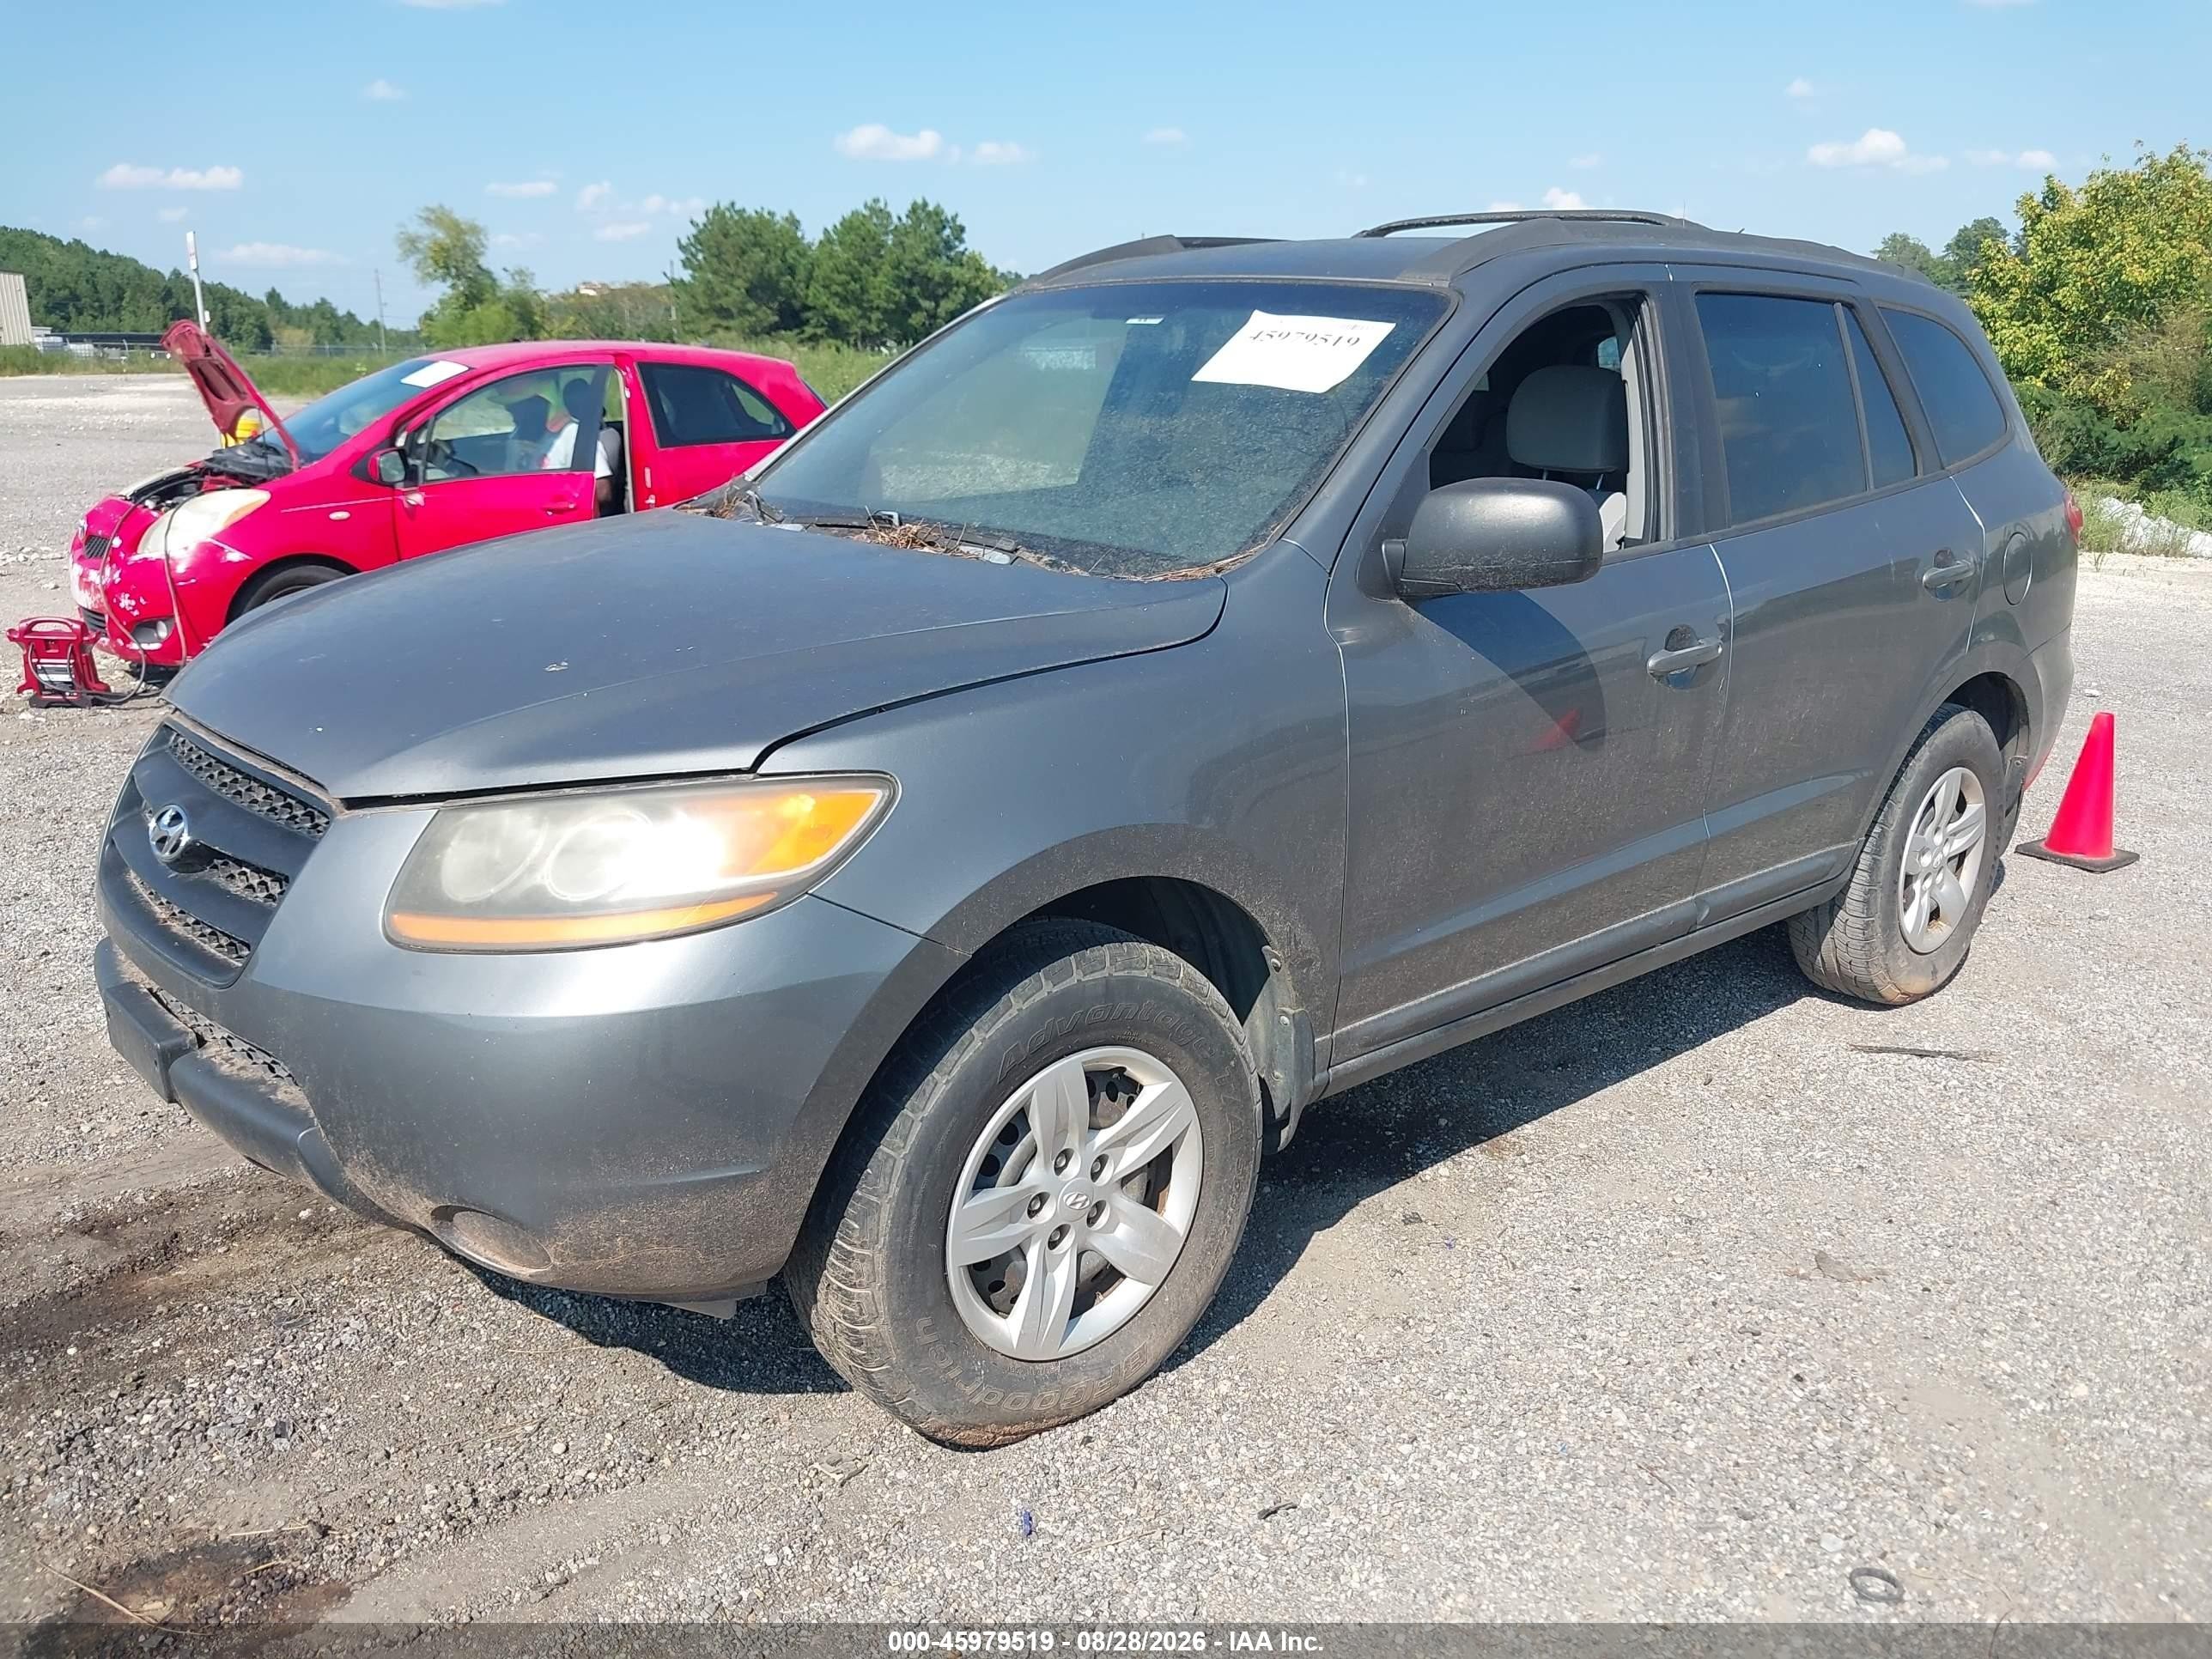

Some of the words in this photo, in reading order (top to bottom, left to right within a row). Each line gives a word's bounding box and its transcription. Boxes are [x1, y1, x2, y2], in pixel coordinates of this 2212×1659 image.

[1249, 330, 1362, 348] 45979519
[996, 1000, 1216, 1085] Advantage
[915, 1316, 1150, 1411] BFGoodrich
